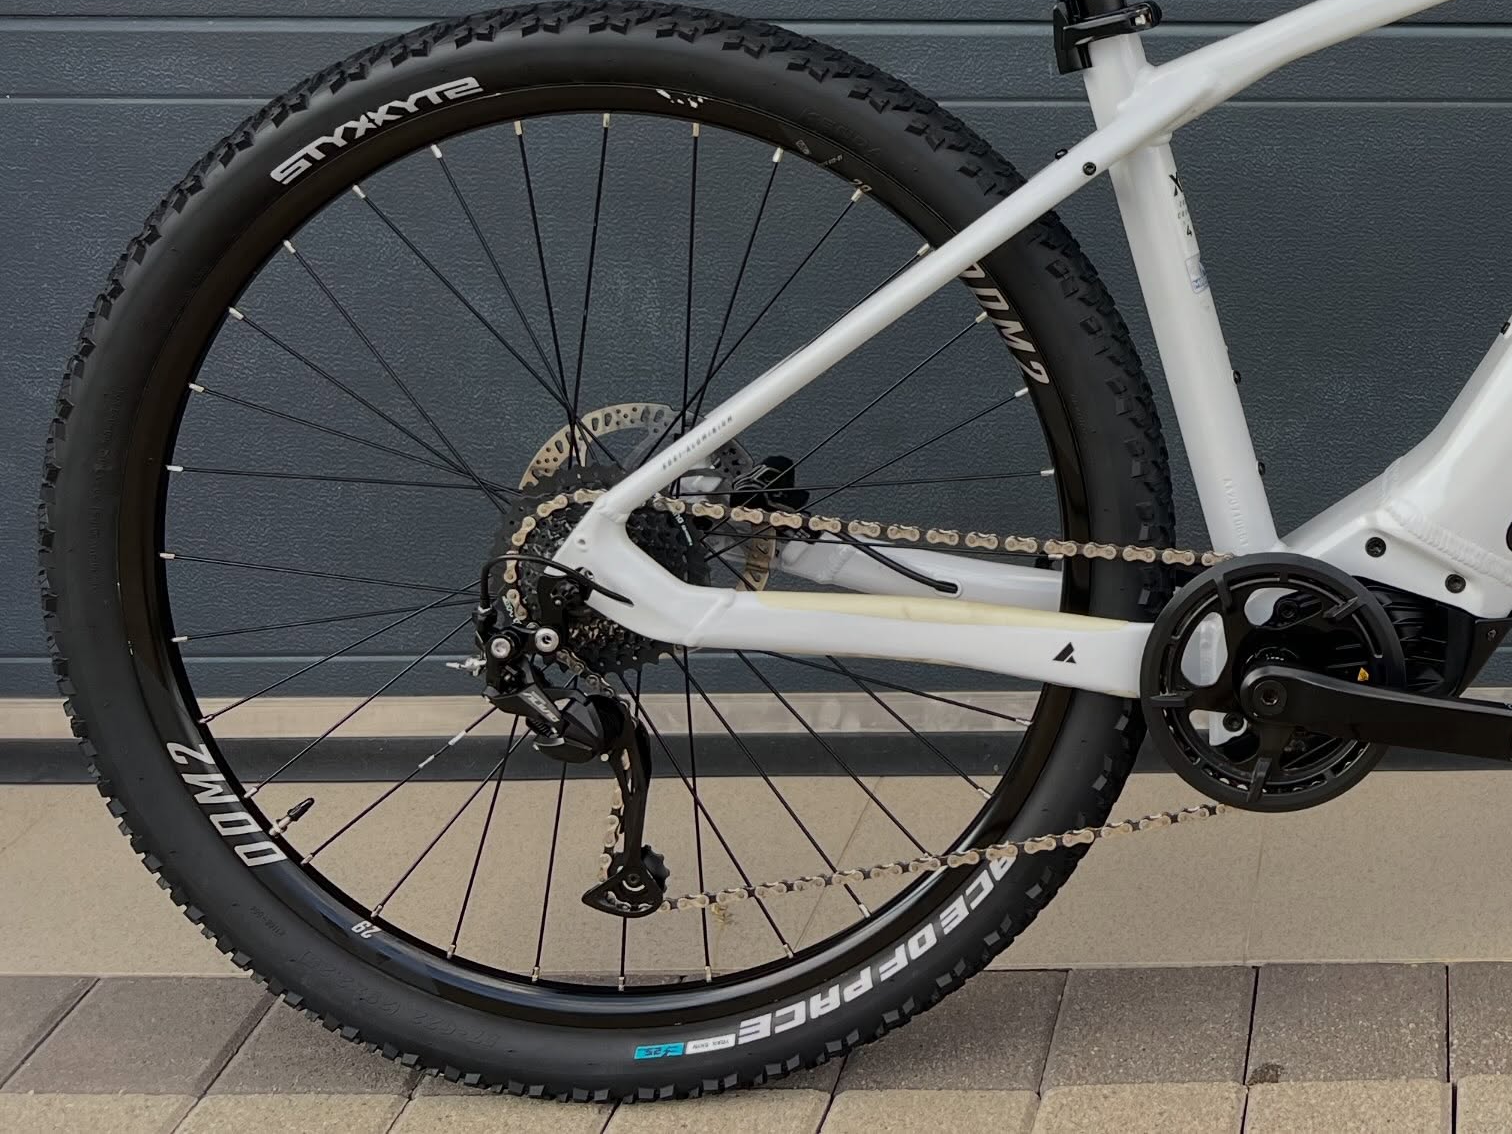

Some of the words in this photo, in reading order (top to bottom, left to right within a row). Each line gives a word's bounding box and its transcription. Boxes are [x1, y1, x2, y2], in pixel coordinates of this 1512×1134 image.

[351, 919, 382, 939] 29
[877, 929, 939, 981] OF
[738, 972, 877, 1045] PACE
